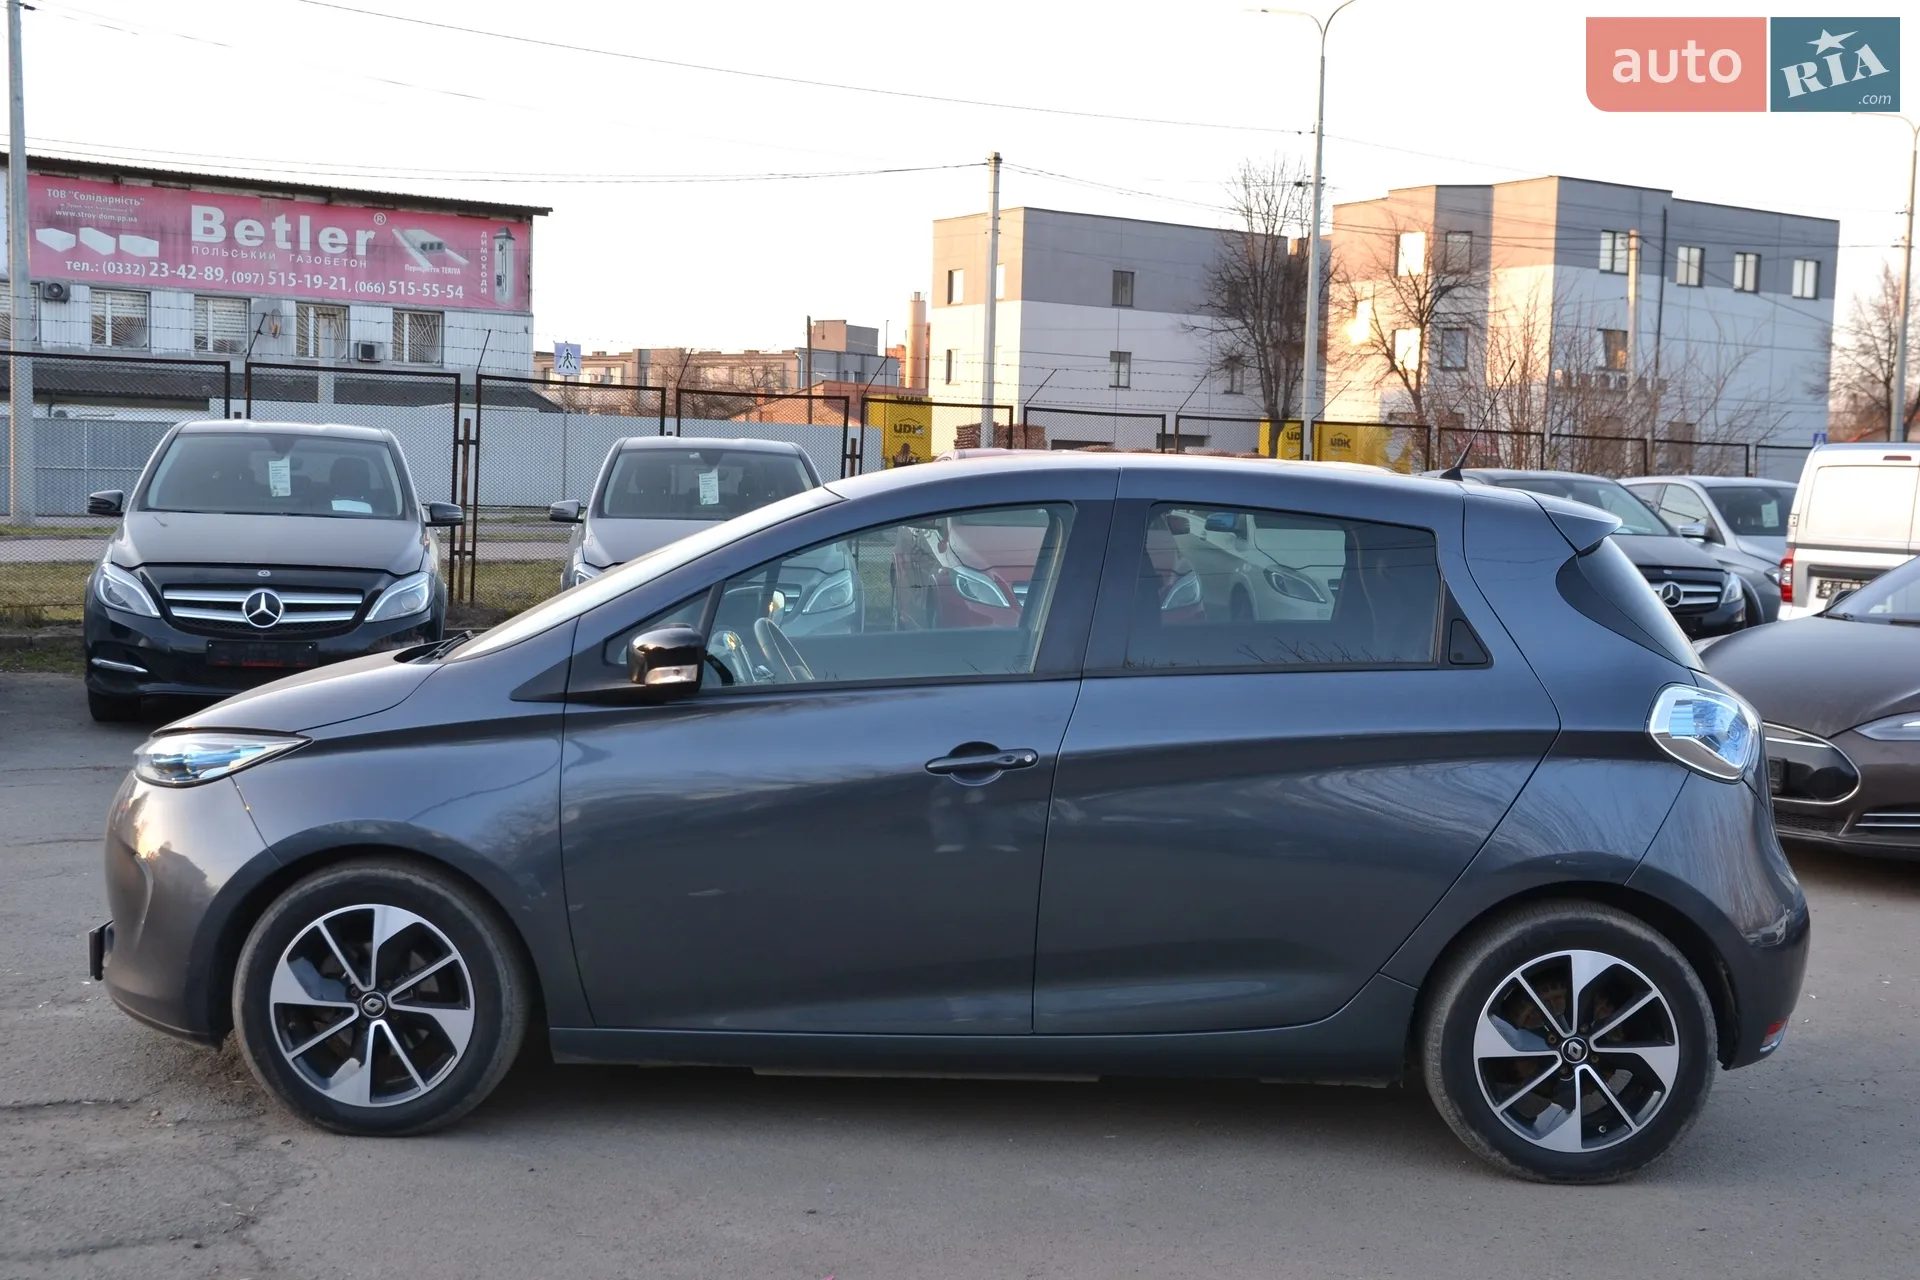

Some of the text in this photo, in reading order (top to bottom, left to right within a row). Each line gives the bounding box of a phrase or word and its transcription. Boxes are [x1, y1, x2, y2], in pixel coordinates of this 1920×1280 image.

[46, 188, 67, 199] ТОВ
[55, 210, 138, 222] www.stroydom.pp.ua
[191, 205, 375, 256] Betler
[289, 253, 367, 269] ГАЗОБЕТОН
[65, 260, 465, 299] тел.: (0332) 23-42-89, (097) 515-19-21, (066) 515-55-54
[1330, 438, 1351, 448] UDK
